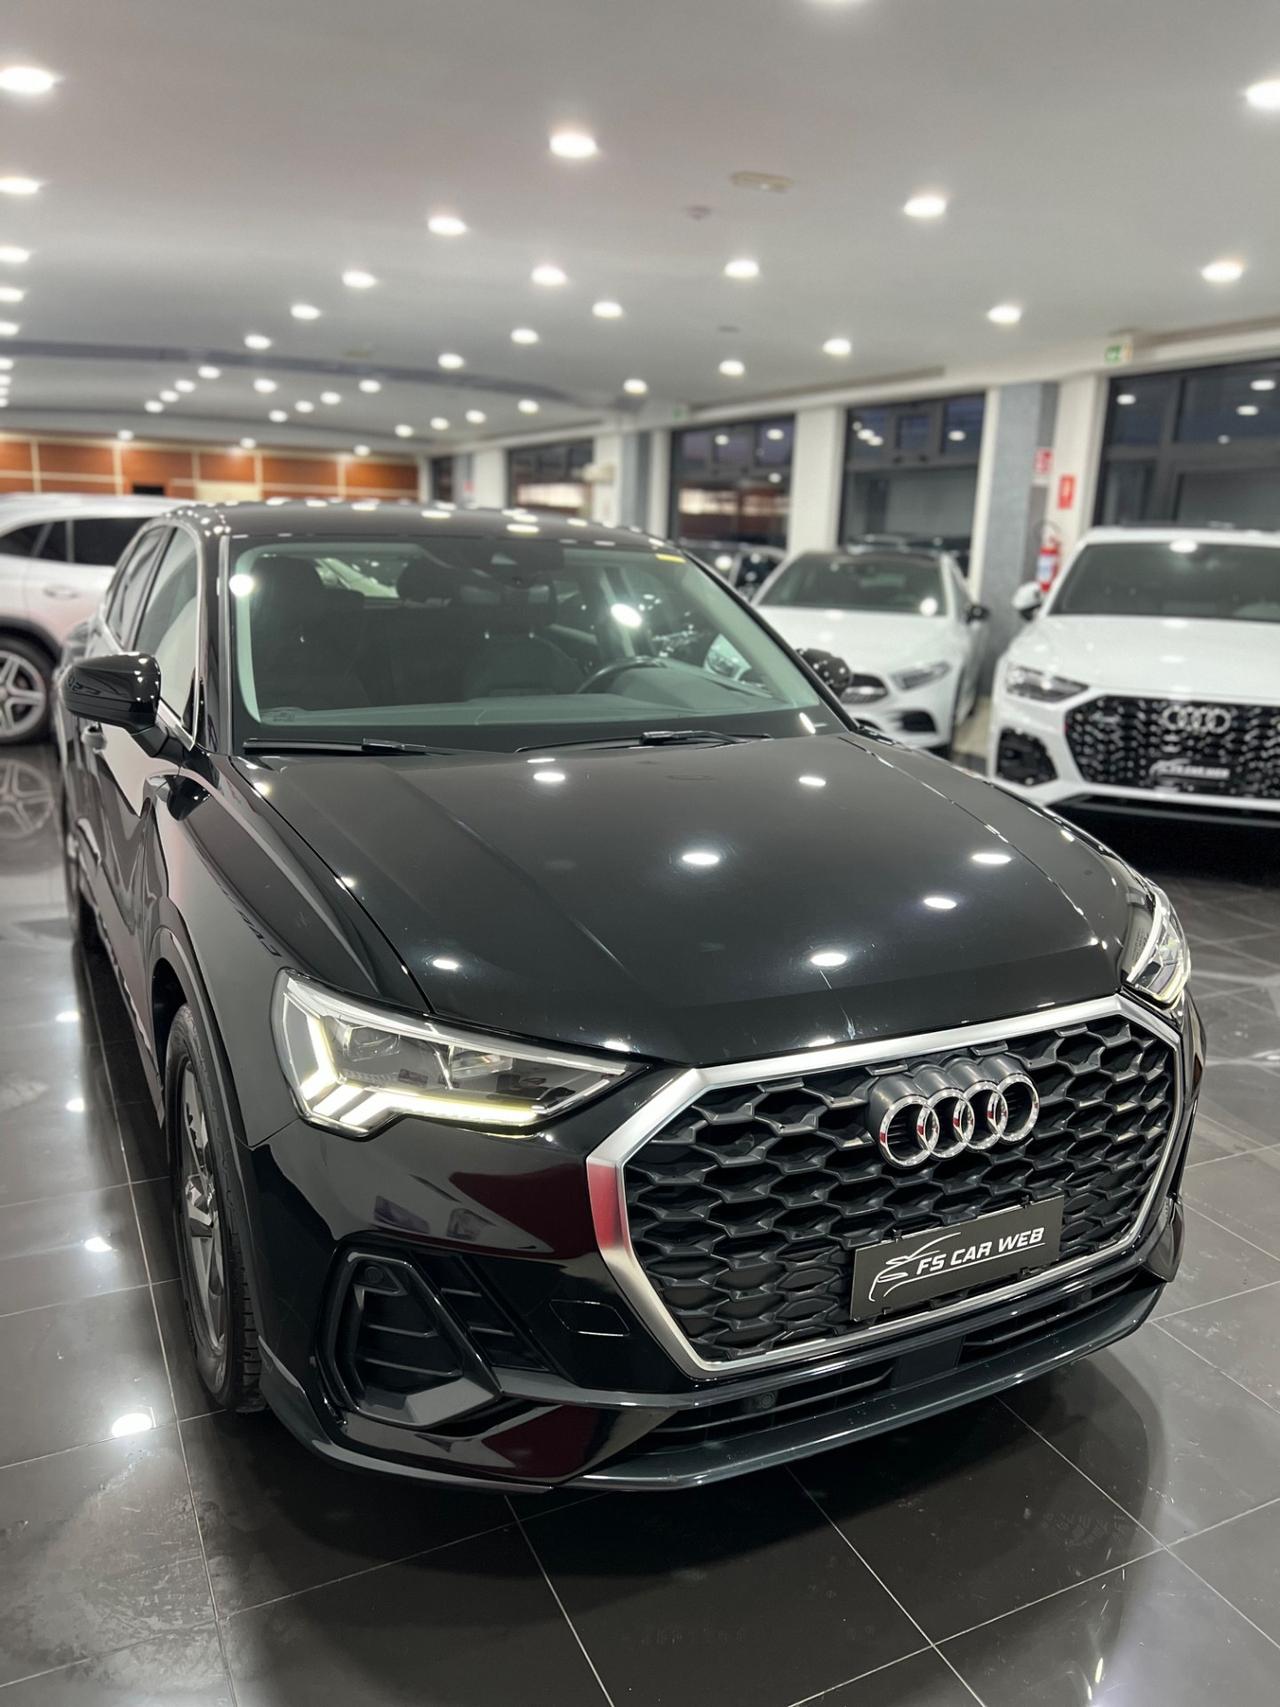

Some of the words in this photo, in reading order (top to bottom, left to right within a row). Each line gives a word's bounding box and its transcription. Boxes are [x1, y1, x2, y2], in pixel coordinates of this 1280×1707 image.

[916, 1253, 947, 1275] FS
[950, 1241, 992, 1266] CAR
[998, 1227, 1045, 1253] WEB
